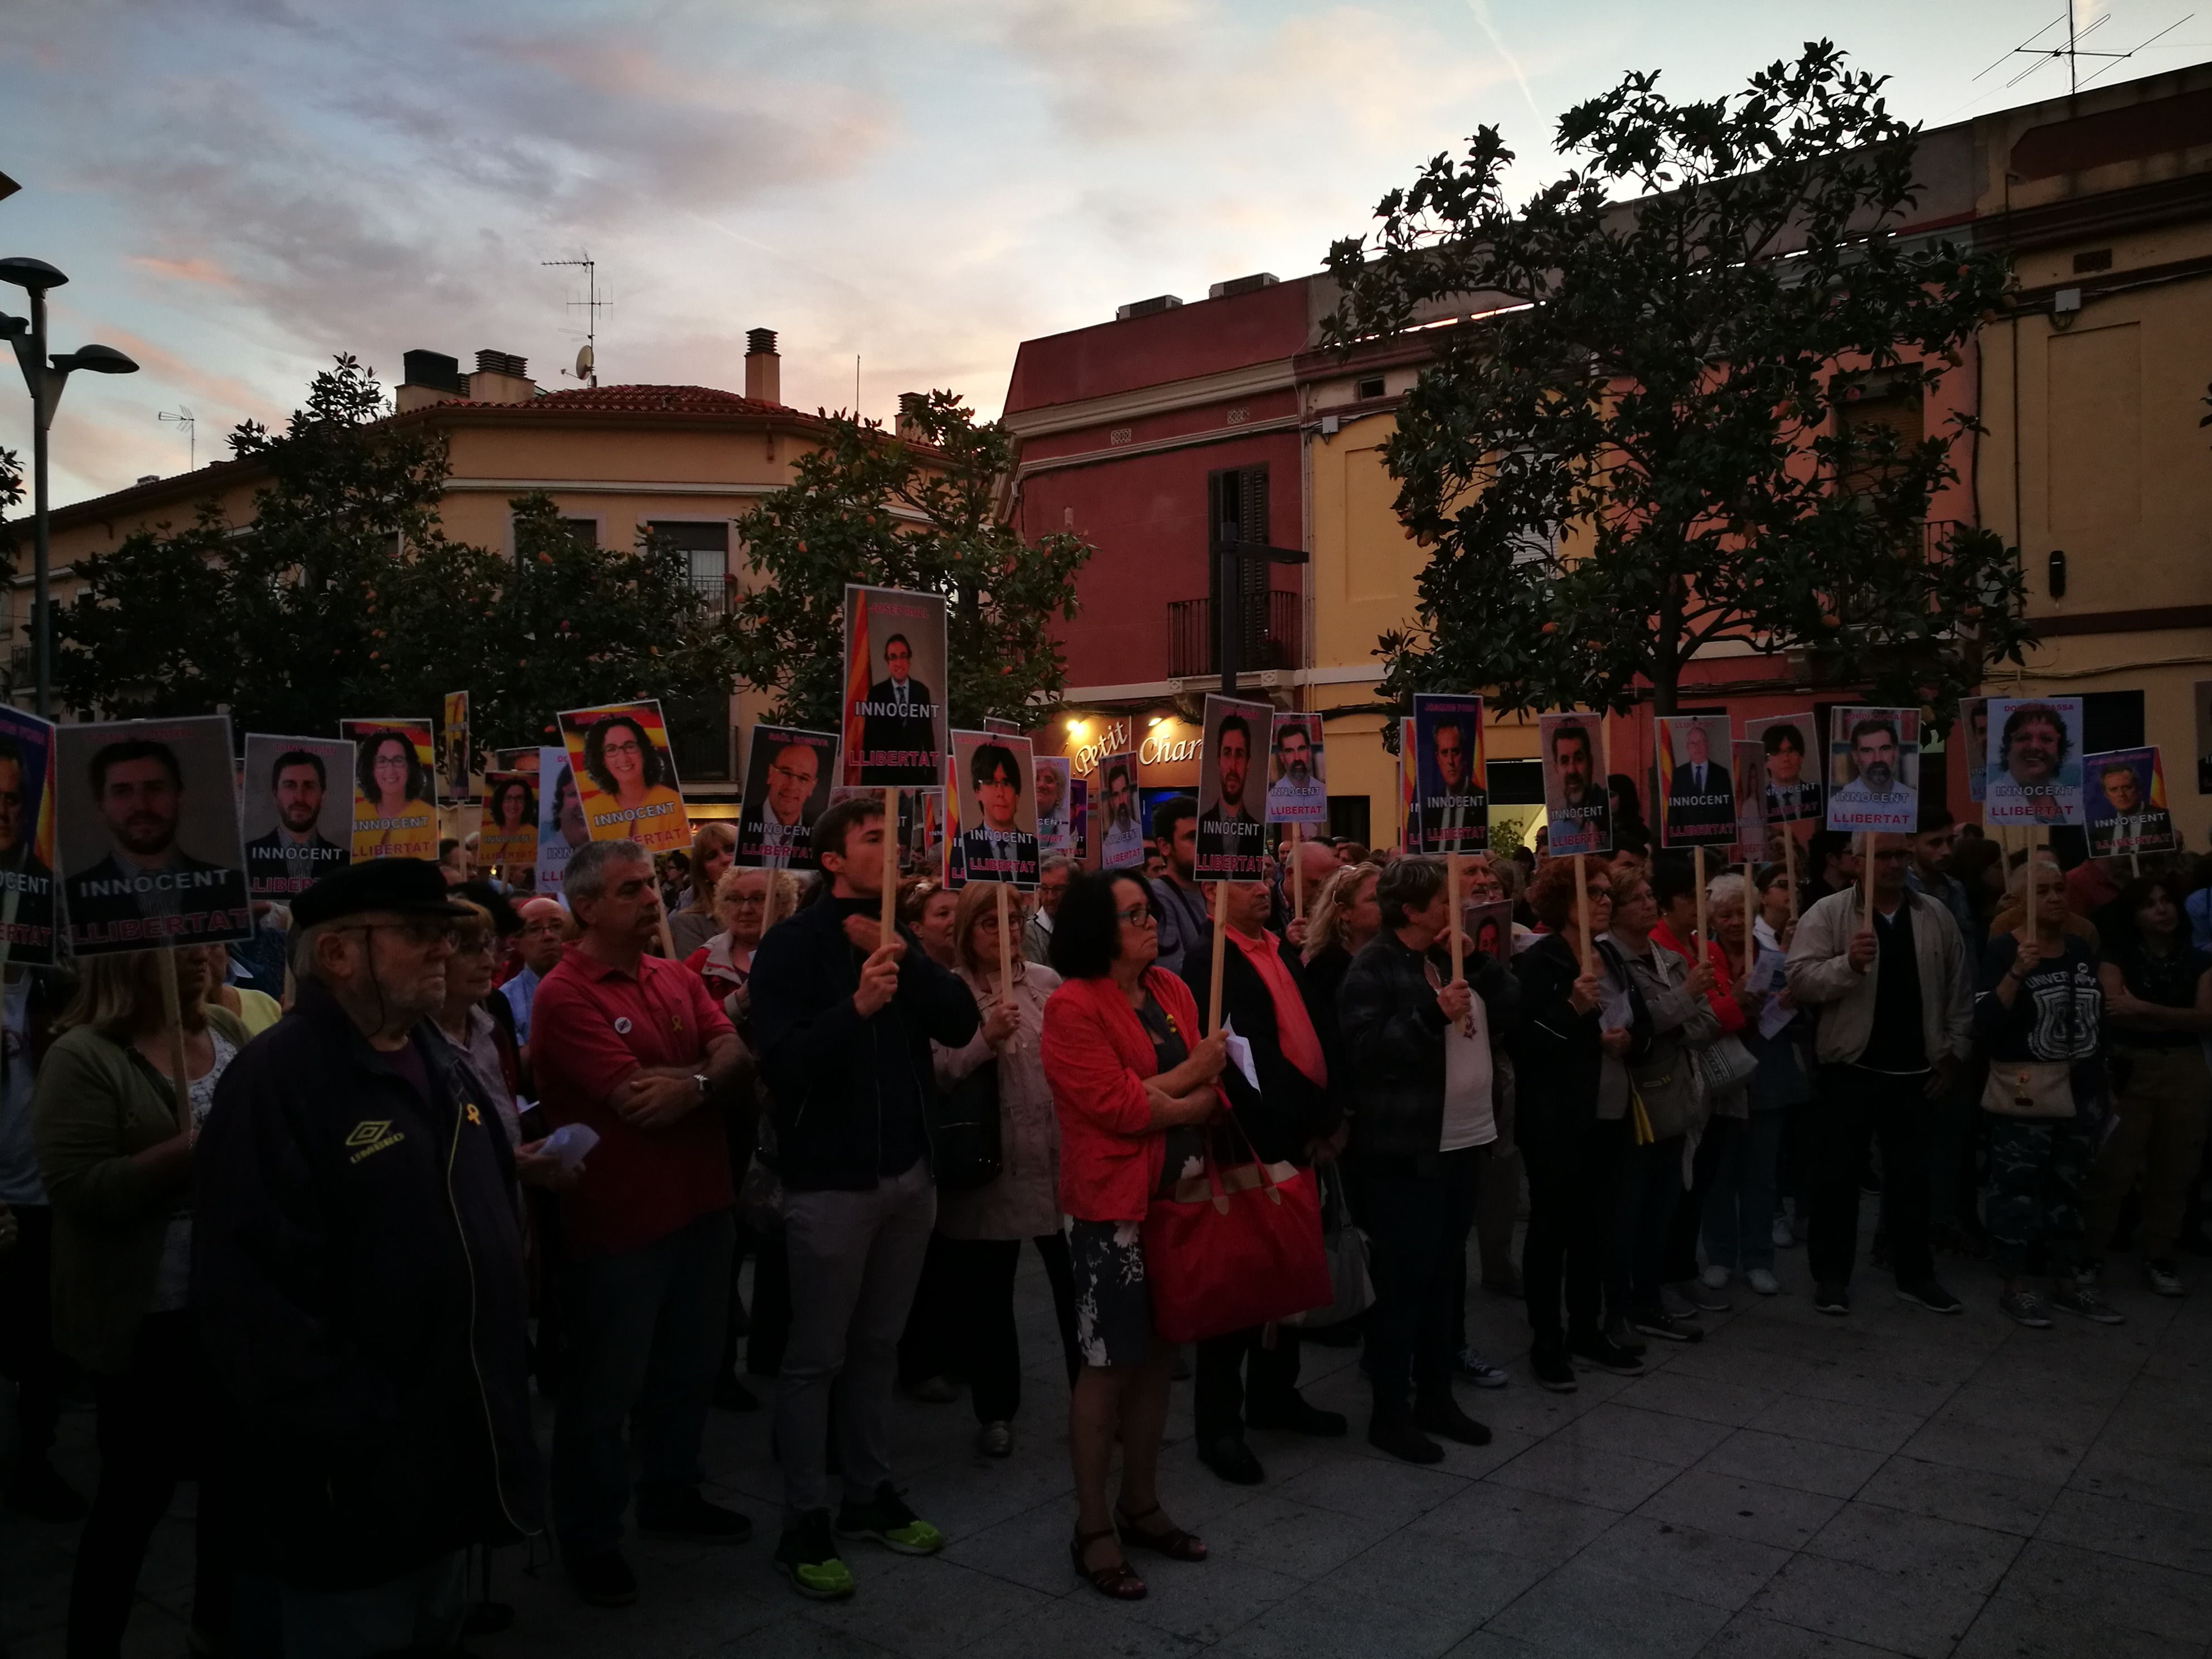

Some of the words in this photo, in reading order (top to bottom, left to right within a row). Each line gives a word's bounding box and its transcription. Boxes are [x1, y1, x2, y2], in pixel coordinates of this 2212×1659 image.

[855, 701, 940, 719] INNOCENT
[1075, 721, 1128, 777] Petit
[848, 750, 940, 768] LLIBERTAT
[1270, 786, 1321, 797] INNOCENT
[1765, 782, 1816, 797] NNOCENT
[1996, 785, 2075, 797] INNOCENT
[1427, 795, 1485, 809] INNOCENT
[1669, 794, 1730, 807] INNOCENT
[1835, 792, 1909, 804] INNOCENT
[593, 802, 676, 827] INNOCENT
[1270, 806, 1322, 815] LLIBERTAT
[1551, 806, 1603, 821] INNOCENT
[1833, 813, 1910, 824] LLIBERTAT
[1992, 806, 2074, 816] LLIBERTAT
[354, 816, 429, 831] INNOCENT
[1203, 820, 1259, 836] INNOCENT
[2094, 812, 2165, 828] INNOCENT
[748, 821, 814, 837] INNOCEN
[970, 829, 1034, 845] INNOCENT
[1427, 827, 1486, 841] LLIBERTAT
[1668, 823, 1735, 837] LLIBERTAT
[1552, 831, 1607, 847] LLIBERTAT
[2095, 833, 2171, 850] LLIBERTAT
[252, 846, 343, 861] INNOCENT
[1105, 848, 1141, 866] LLIBERTAT
[969, 857, 1036, 874] LLIBERTAT
[1196, 853, 1264, 872] LLIBERTAT
[80, 869, 230, 898] INNOCENT
[250, 876, 322, 893] LIBER
[71, 908, 251, 945] LLIBERTAT
